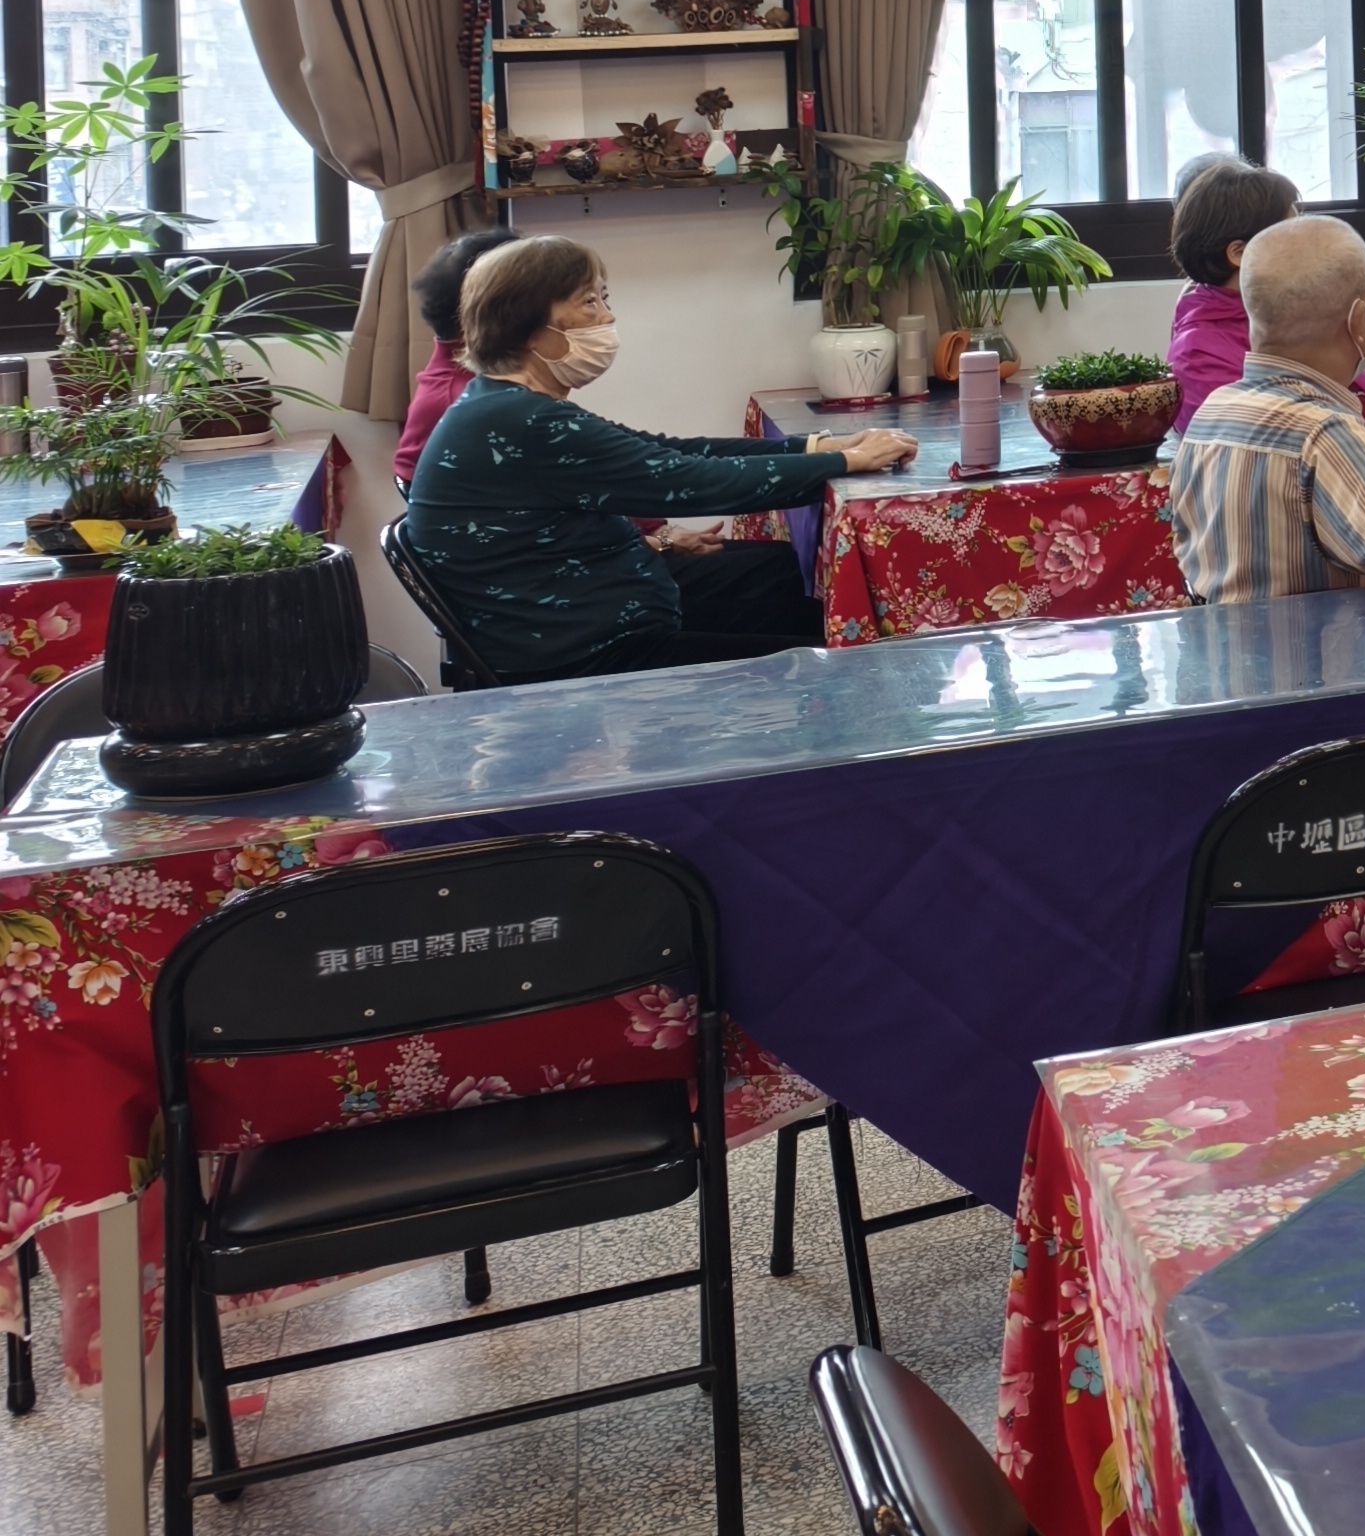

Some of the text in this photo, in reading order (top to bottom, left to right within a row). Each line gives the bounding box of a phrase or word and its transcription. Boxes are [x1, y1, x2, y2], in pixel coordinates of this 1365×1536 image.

[316, 916, 560, 976] 東興里發展協會
